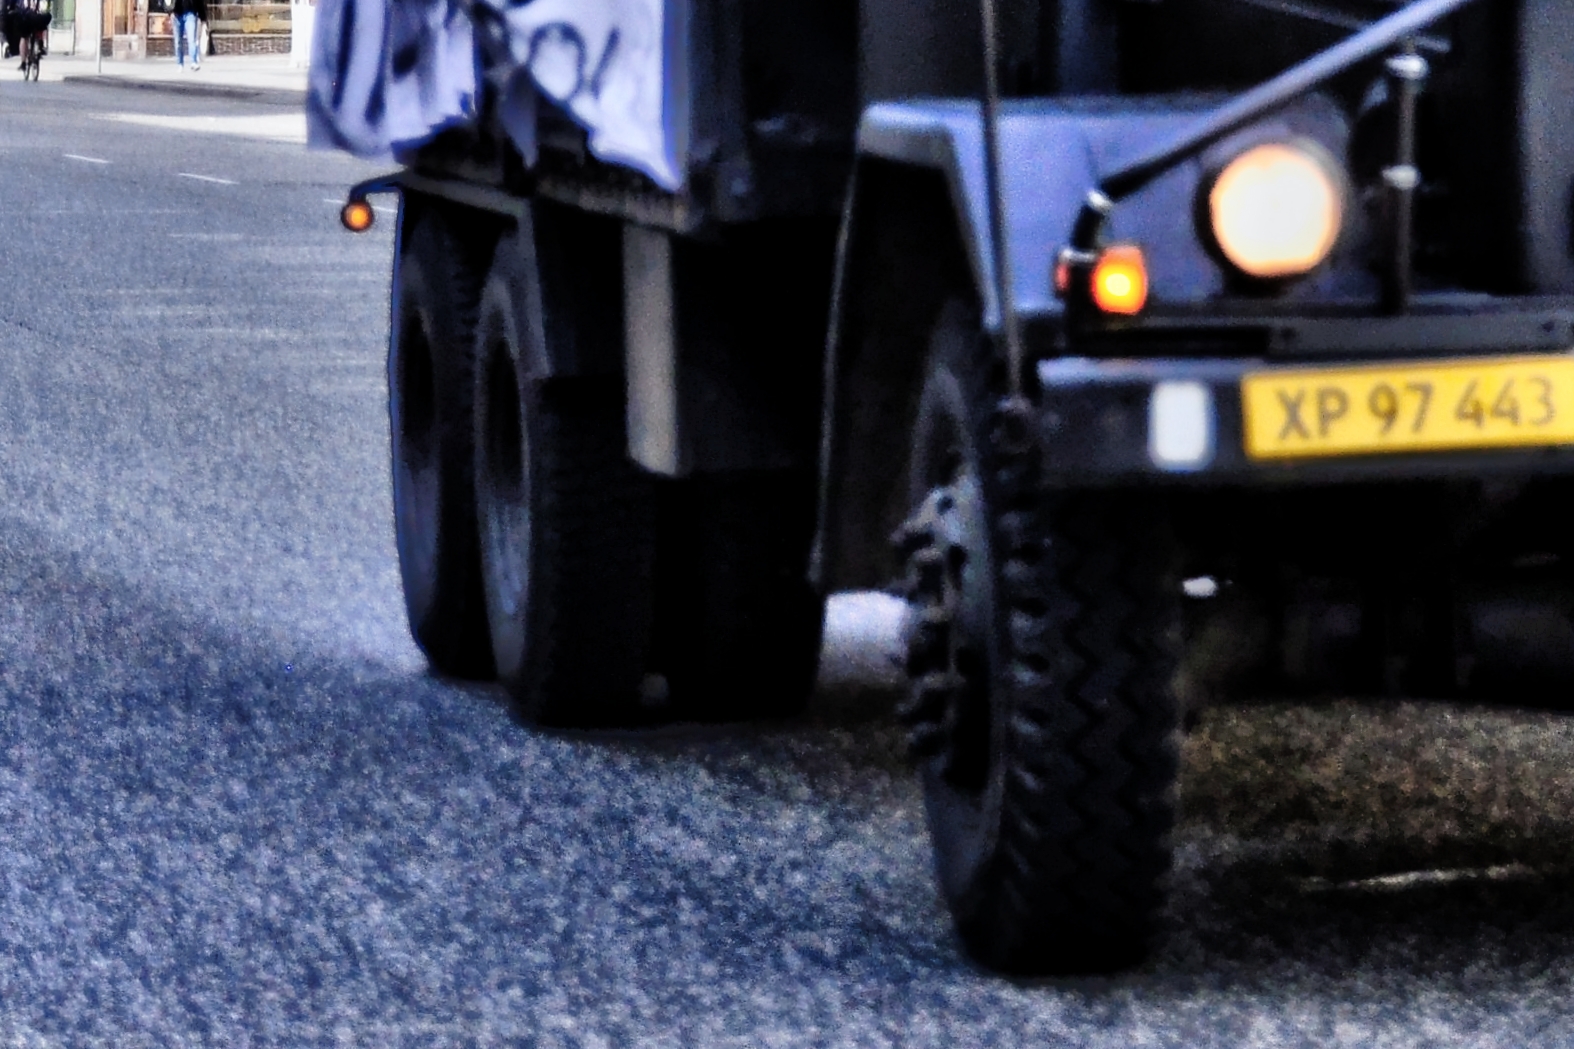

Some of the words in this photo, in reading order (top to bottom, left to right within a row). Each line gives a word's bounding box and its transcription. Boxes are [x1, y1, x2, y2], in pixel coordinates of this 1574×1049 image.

[1276, 386, 1349, 441] XP
[1367, 379, 1434, 435] 97
[1453, 374, 1556, 429] 443
